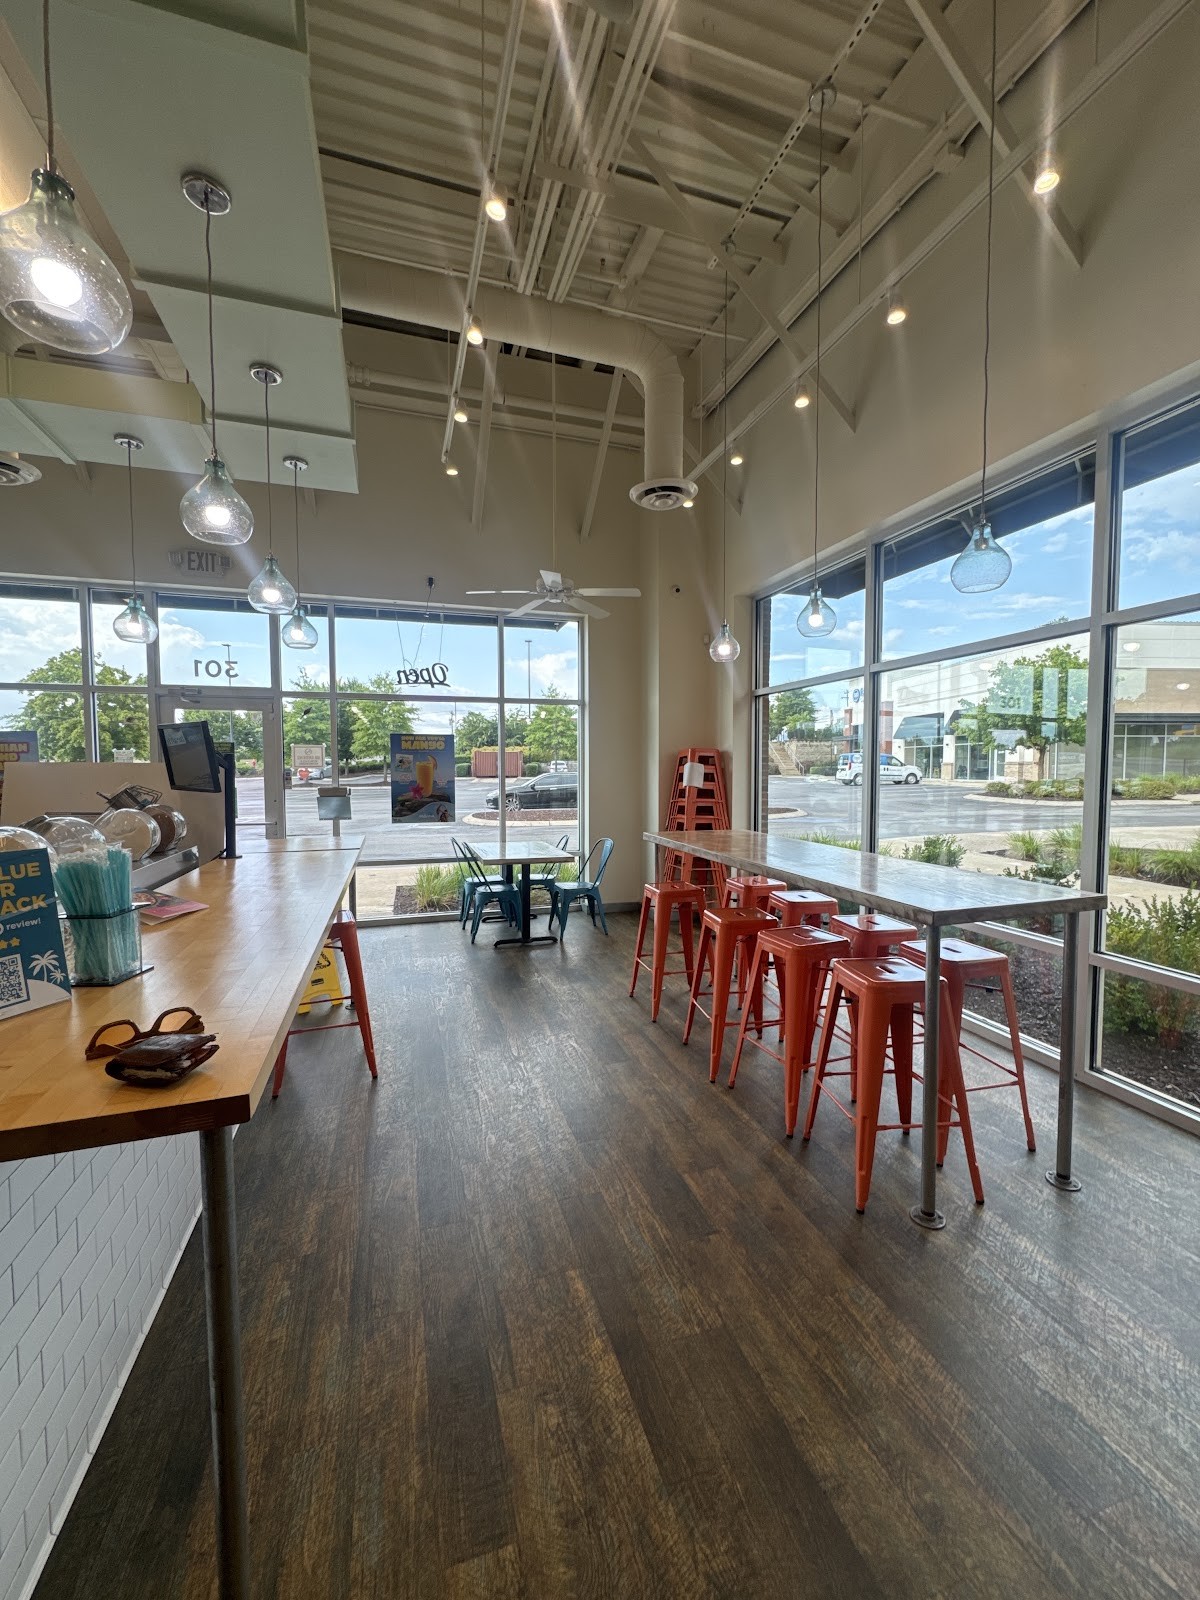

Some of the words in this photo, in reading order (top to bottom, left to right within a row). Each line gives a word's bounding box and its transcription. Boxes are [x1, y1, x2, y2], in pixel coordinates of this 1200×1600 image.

[187, 551, 217, 572] EXIT
[0, 894, 48, 915] ACK
[6, 918, 41, 930] review!
